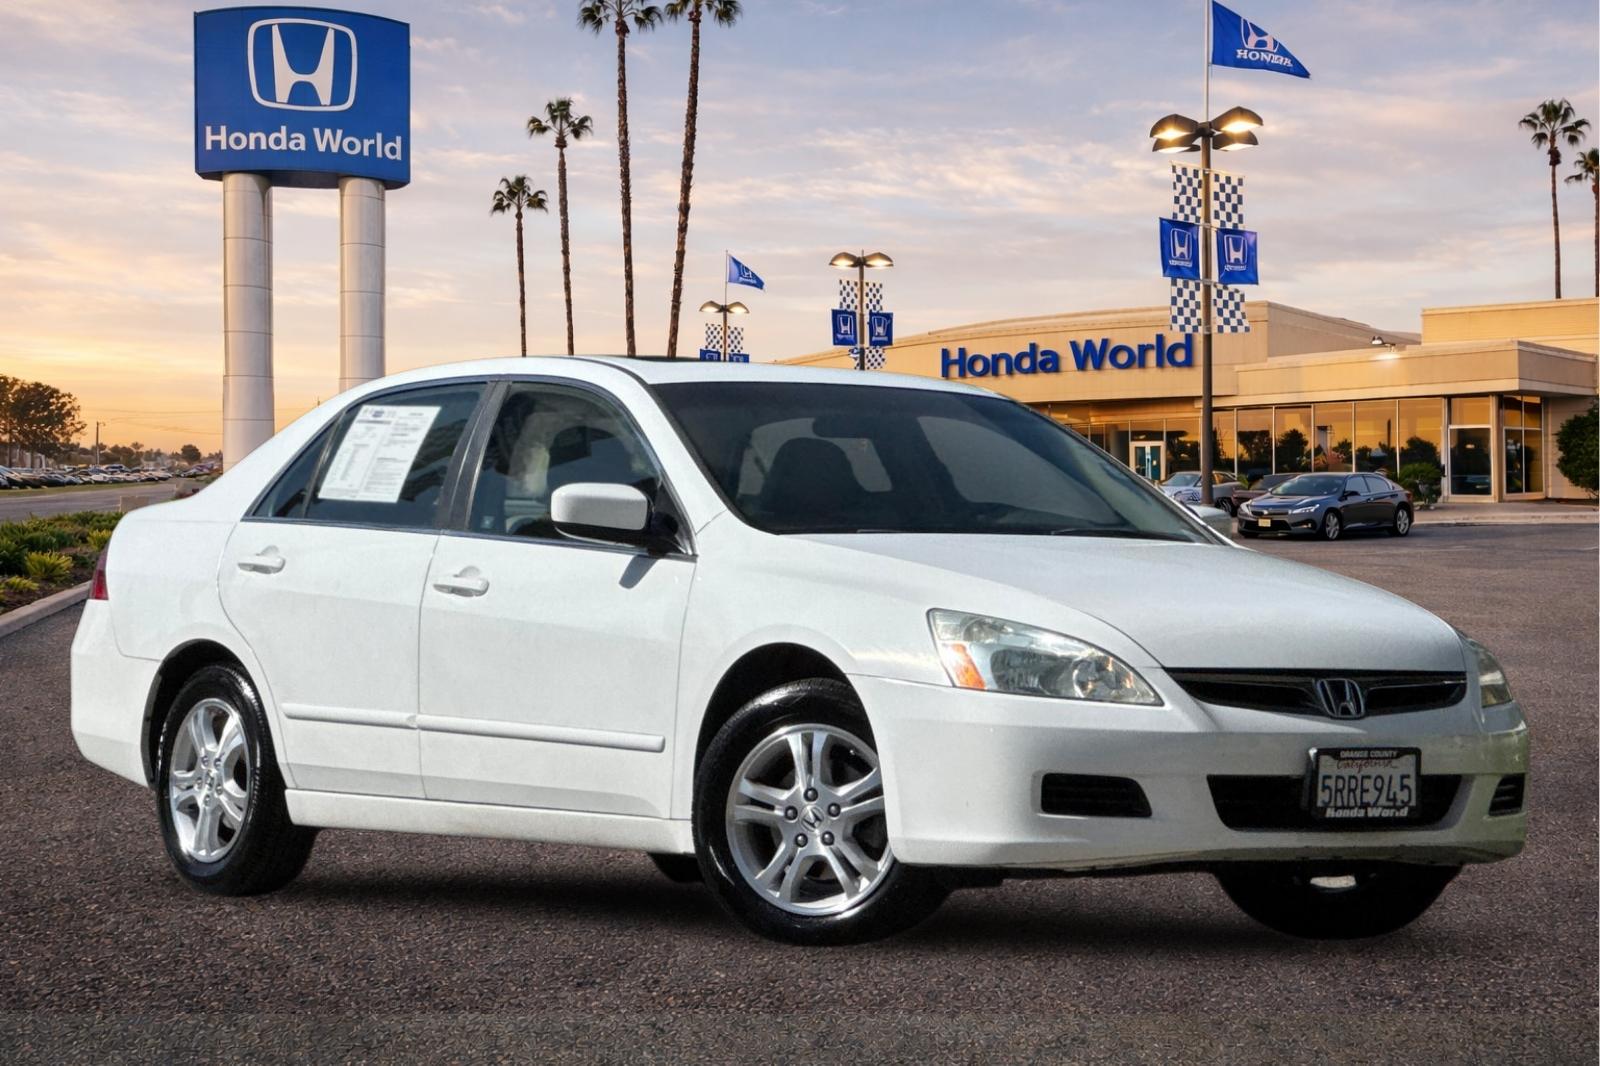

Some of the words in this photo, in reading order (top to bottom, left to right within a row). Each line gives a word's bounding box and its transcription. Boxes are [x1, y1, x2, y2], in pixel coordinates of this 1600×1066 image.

[205, 125, 306, 151] Honda
[312, 127, 402, 160] World
[941, 342, 1060, 378] Honda
[1069, 333, 1194, 371] World
[1340, 750, 1369, 758] ORANGE
[1370, 750, 1398, 758] COUNTY
[1321, 774, 1412, 807] 5RRE945
[1325, 807, 1366, 818] Honda
